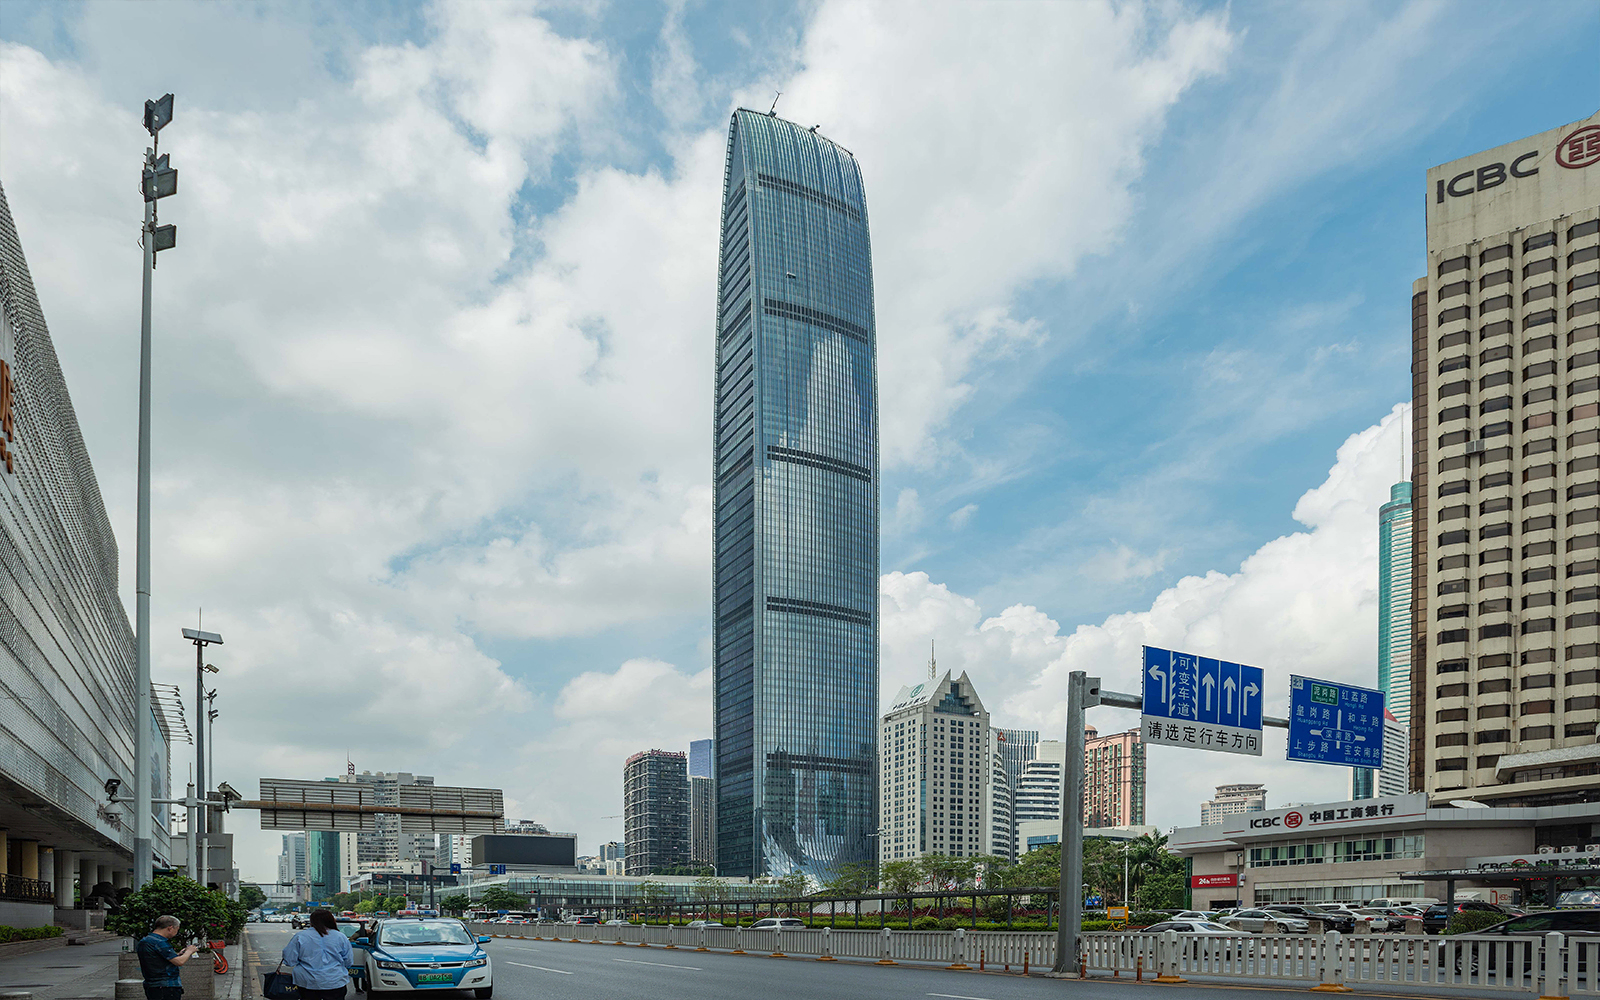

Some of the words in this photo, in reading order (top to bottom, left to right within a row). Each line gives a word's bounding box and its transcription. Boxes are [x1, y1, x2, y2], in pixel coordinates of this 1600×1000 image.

[1437, 150, 1540, 204] ICBC
[1178, 656, 1191, 717] 可变车道
[1341, 689, 1368, 704] 红荔路
[1296, 705, 1330, 720] 皇岗路
[1347, 712, 1379, 727] 和平路
[1148, 721, 1257, 751] 请选定行车方向
[1294, 739, 1329, 753] 上步路
[1344, 745, 1380, 758] 宝安南路
[1250, 816, 1281, 829] ICBC
